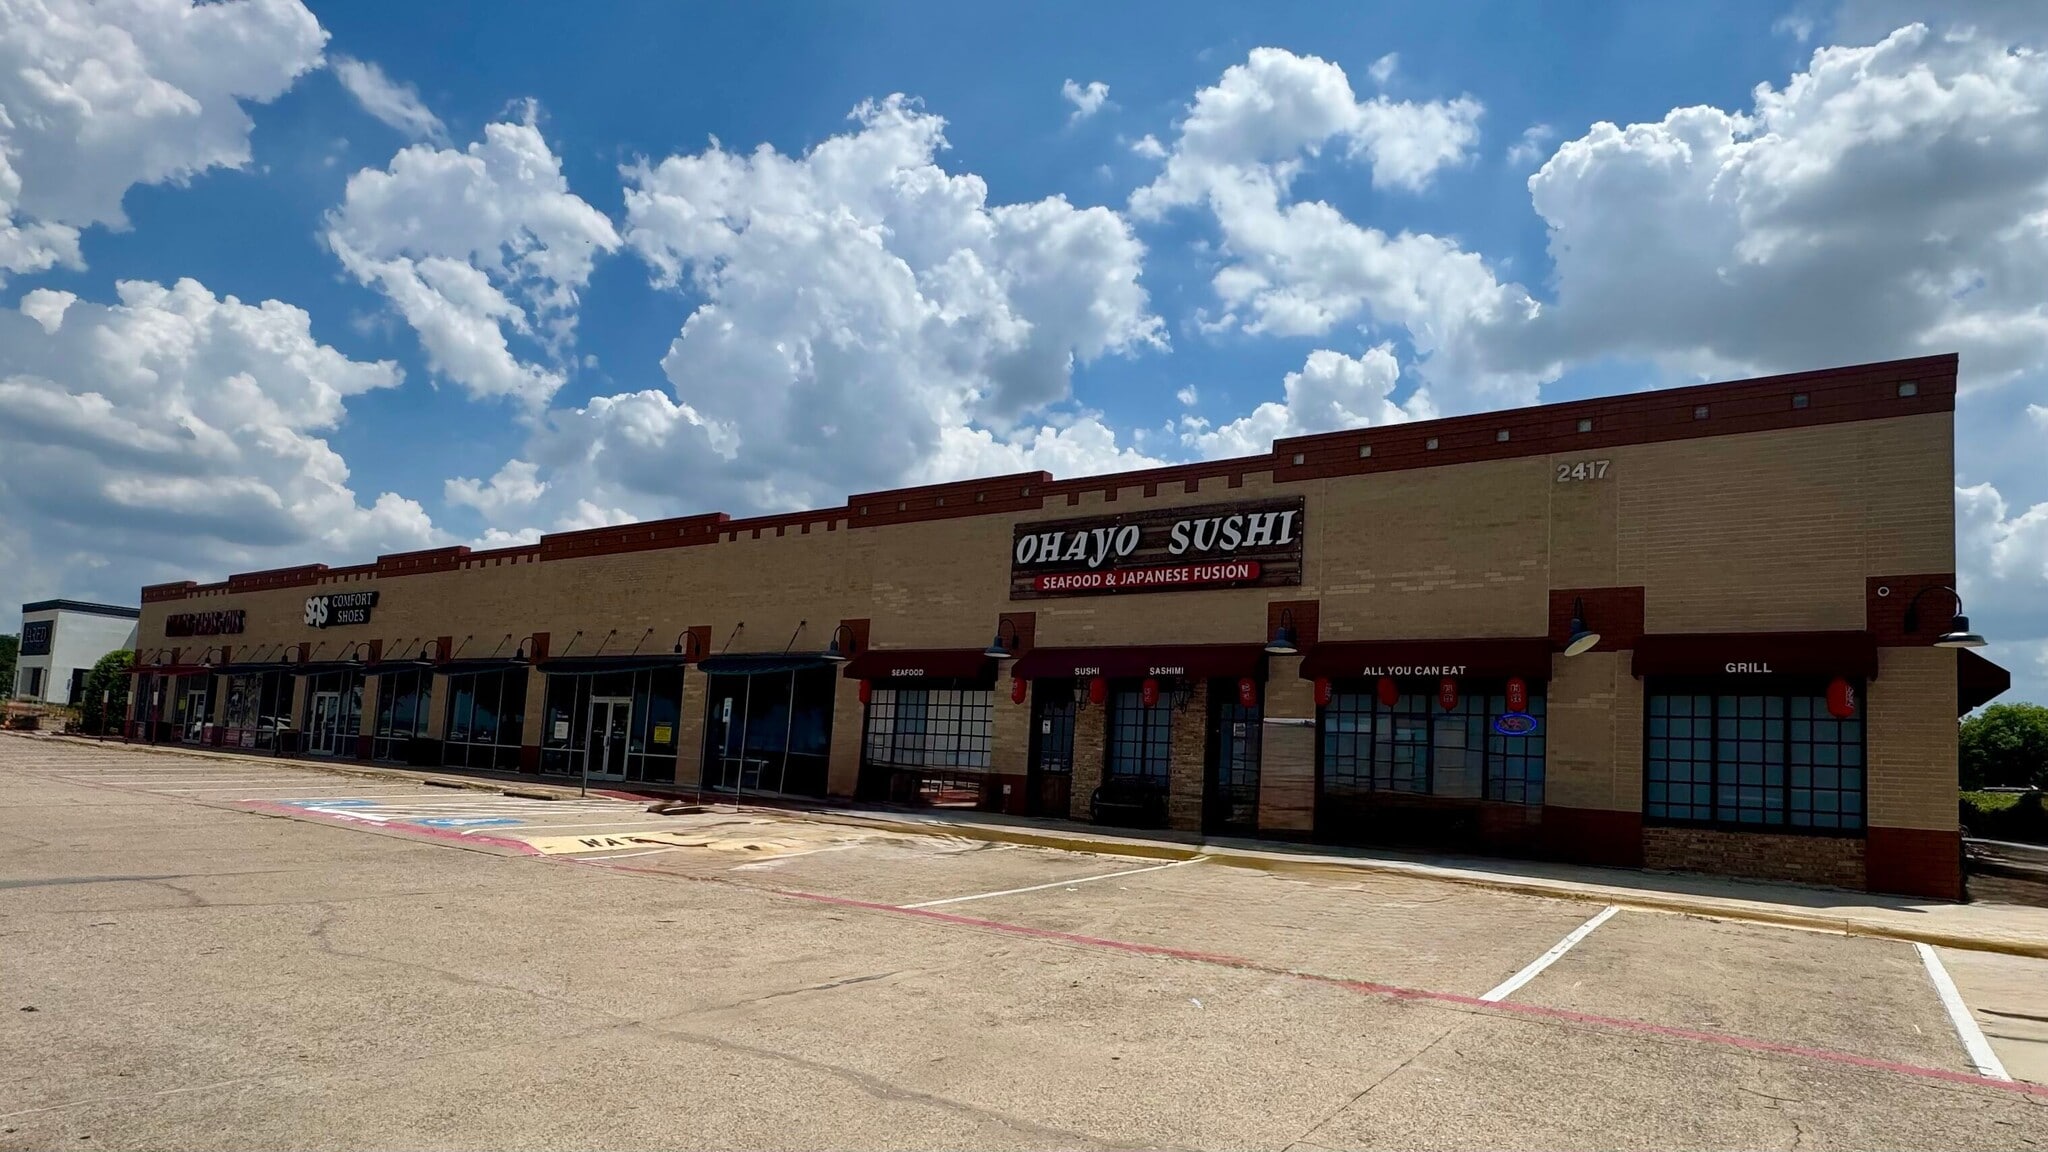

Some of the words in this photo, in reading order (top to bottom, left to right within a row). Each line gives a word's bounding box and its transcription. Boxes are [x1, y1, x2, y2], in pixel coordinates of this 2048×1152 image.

[1556, 459, 1610, 482] 2417
[1015, 524, 1140, 568] OHAYO
[1168, 510, 1300, 554] SUSHI
[1043, 573, 1101, 589] SEAFOOD
[1105, 573, 1117, 586] &
[1119, 567, 1189, 586] JAPANESE
[1193, 564, 1249, 581] FUSION
[331, 592, 373, 608] COMFORT
[337, 609, 365, 623] SHOES
[891, 668, 924, 677] SEAFOOD
[1074, 667, 1100, 676] SUSHI
[1149, 667, 1184, 675] SASHIMI
[1363, 666, 1385, 676] ALL
[1387, 666, 1412, 676] YOU
[1414, 666, 1440, 676] CAN
[1442, 665, 1467, 675] EAT
[1725, 662, 1773, 673] GRILL
